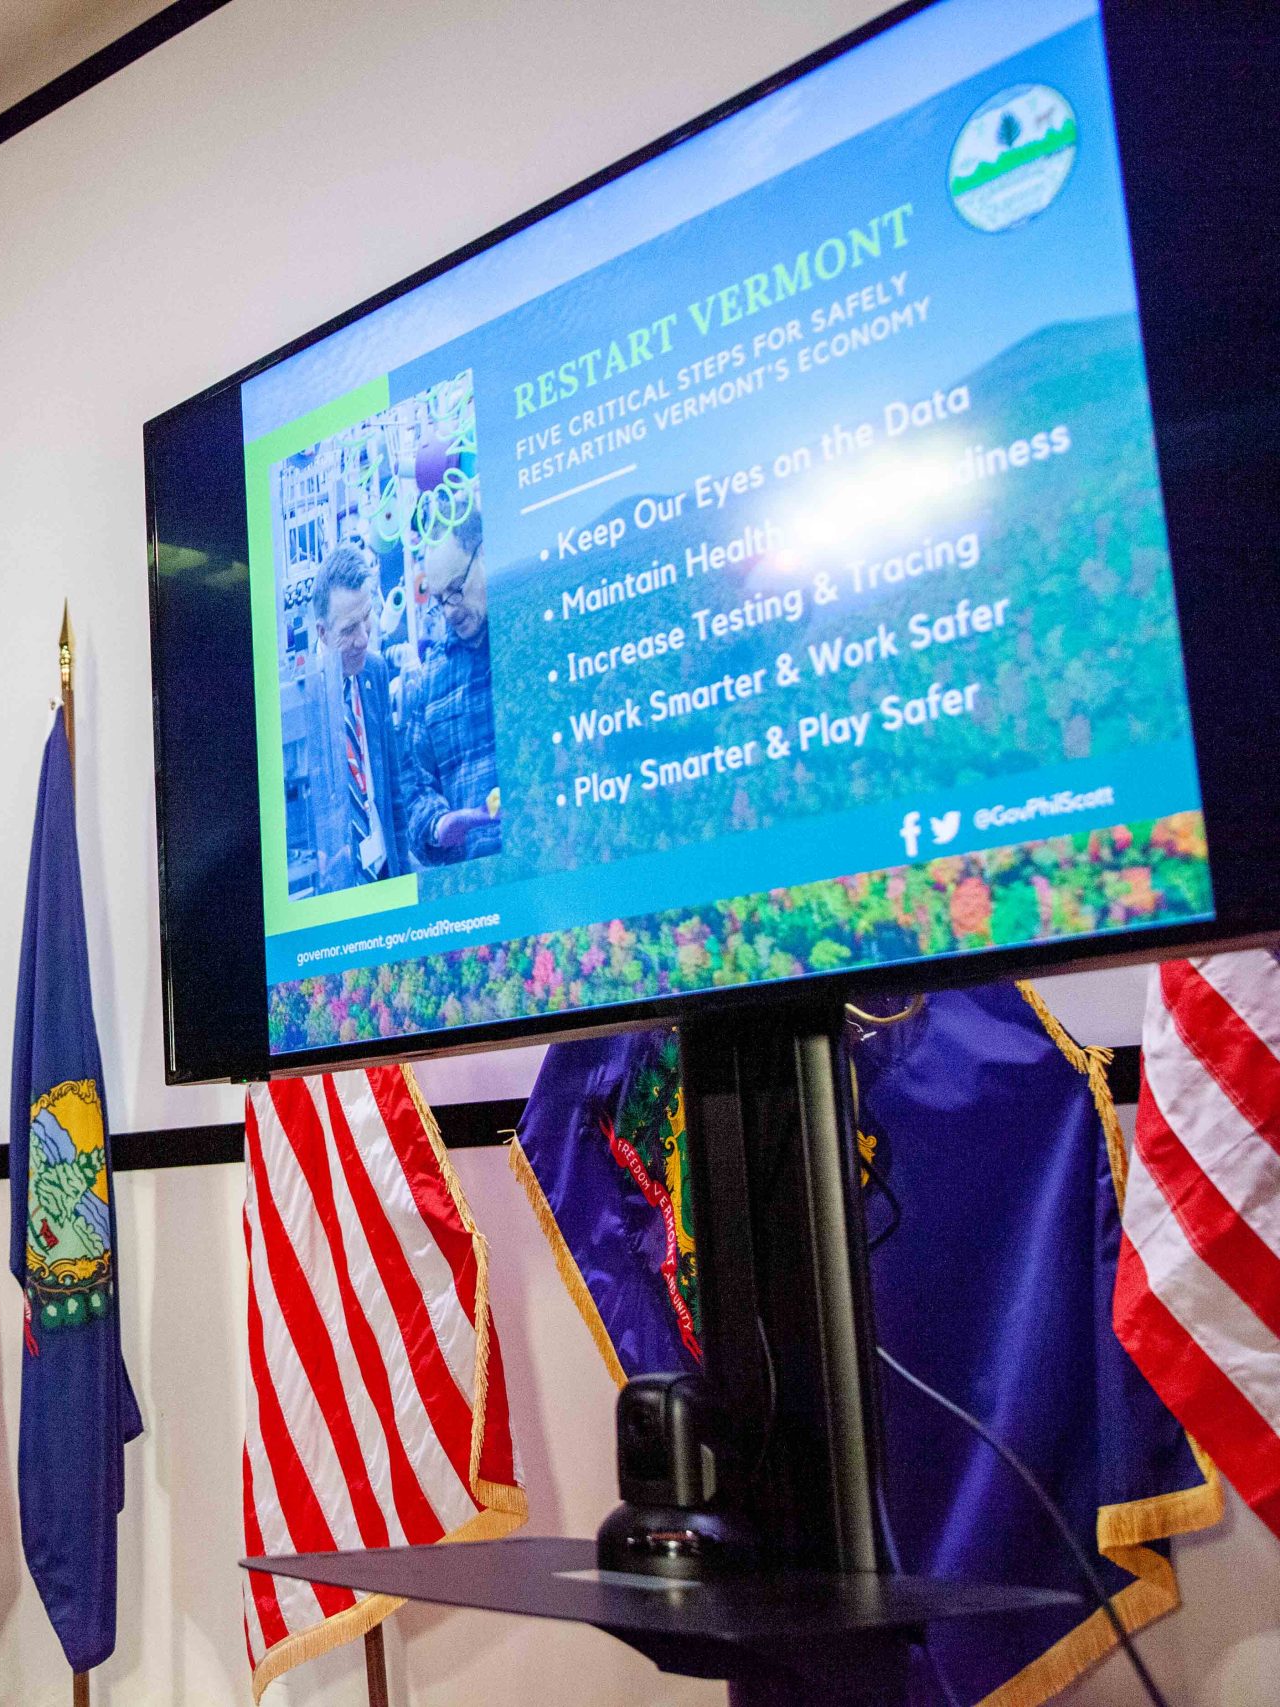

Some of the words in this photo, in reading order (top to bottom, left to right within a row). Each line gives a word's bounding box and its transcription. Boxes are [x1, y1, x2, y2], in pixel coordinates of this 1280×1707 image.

[514, 314, 677, 418] RESTART
[688, 203, 914, 336] VERMONT
[516, 422, 562, 460] FIVE
[568, 384, 671, 437] CRITICAL
[676, 344, 747, 391] STEPS
[752, 320, 804, 358] FOR
[811, 271, 909, 332] SAFELY
[518, 420, 648, 489] RESTARTING
[653, 359, 790, 431] VERMONT'S
[798, 296, 932, 369] ECONOMY
[557, 515, 626, 560] Keep
[634, 490, 686, 530] Our
[694, 464, 765, 511] Eyes
[774, 446, 811, 478] on
[822, 421, 875, 462] the
[884, 383, 971, 437] Data
[561, 553, 678, 621] Maintain
[566, 625, 685, 683] Increase
[692, 584, 804, 642] Testing
[812, 569, 838, 606] &
[846, 531, 981, 594] Tracing
[569, 698, 642, 744] Work
[650, 665, 766, 722] Smarter
[775, 653, 800, 688] &
[808, 623, 898, 677] Work
[907, 597, 1011, 650] Safer
[573, 768, 632, 807] Play
[640, 734, 758, 791] Smarter
[766, 724, 791, 760] &
[799, 709, 871, 752] Play
[881, 682, 981, 733] Safer
[297, 913, 500, 967] governor.vermont.gov/covid19response
[618, 1140, 651, 1190] FREEDOM
[654, 1183, 676, 1266] VERMONT
[673, 1294, 692, 1331] UNITY
